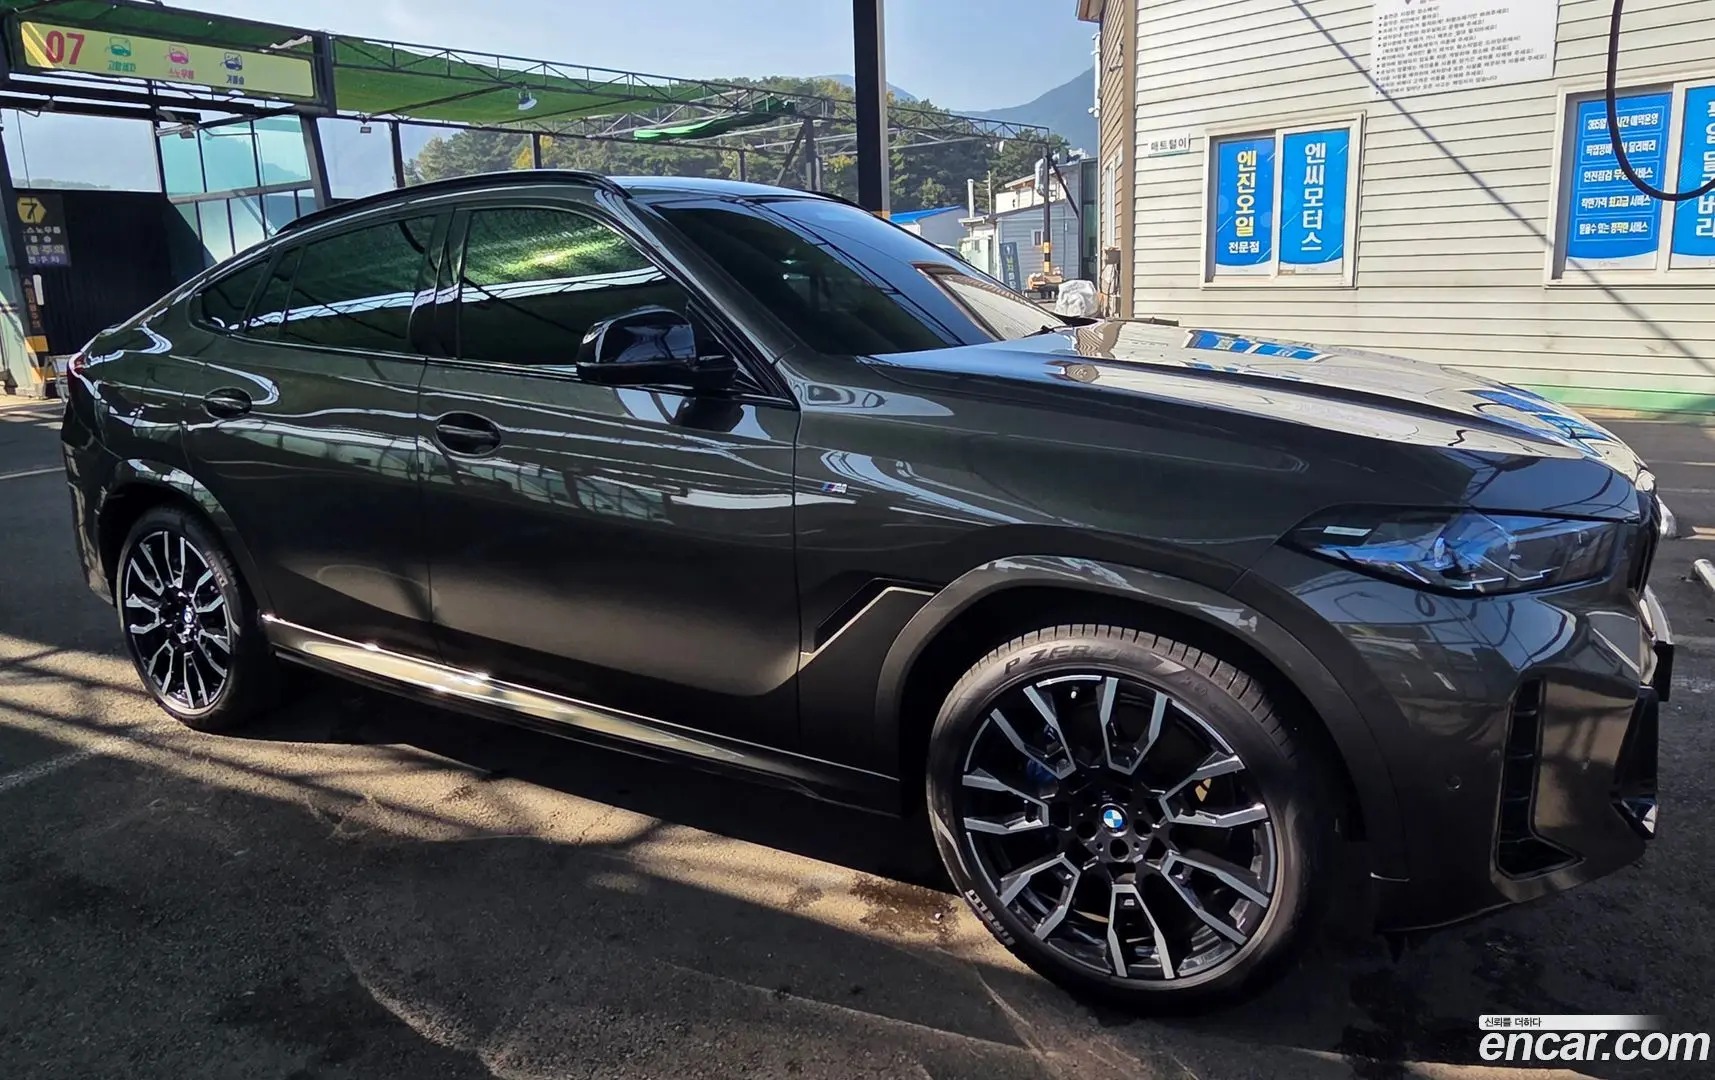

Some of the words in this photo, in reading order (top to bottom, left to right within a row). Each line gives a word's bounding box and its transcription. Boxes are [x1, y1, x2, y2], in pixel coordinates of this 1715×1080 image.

[46, 30, 85, 65] 07
[1151, 137, 1187, 152] 매트털이
[1235, 150, 1257, 237] 엔진오일
[1301, 142, 1327, 251] 엔씨모터스
[21, 202, 38, 220] 7
[1228, 241, 1260, 254] 전문점
[1004, 657, 1021, 675] P
